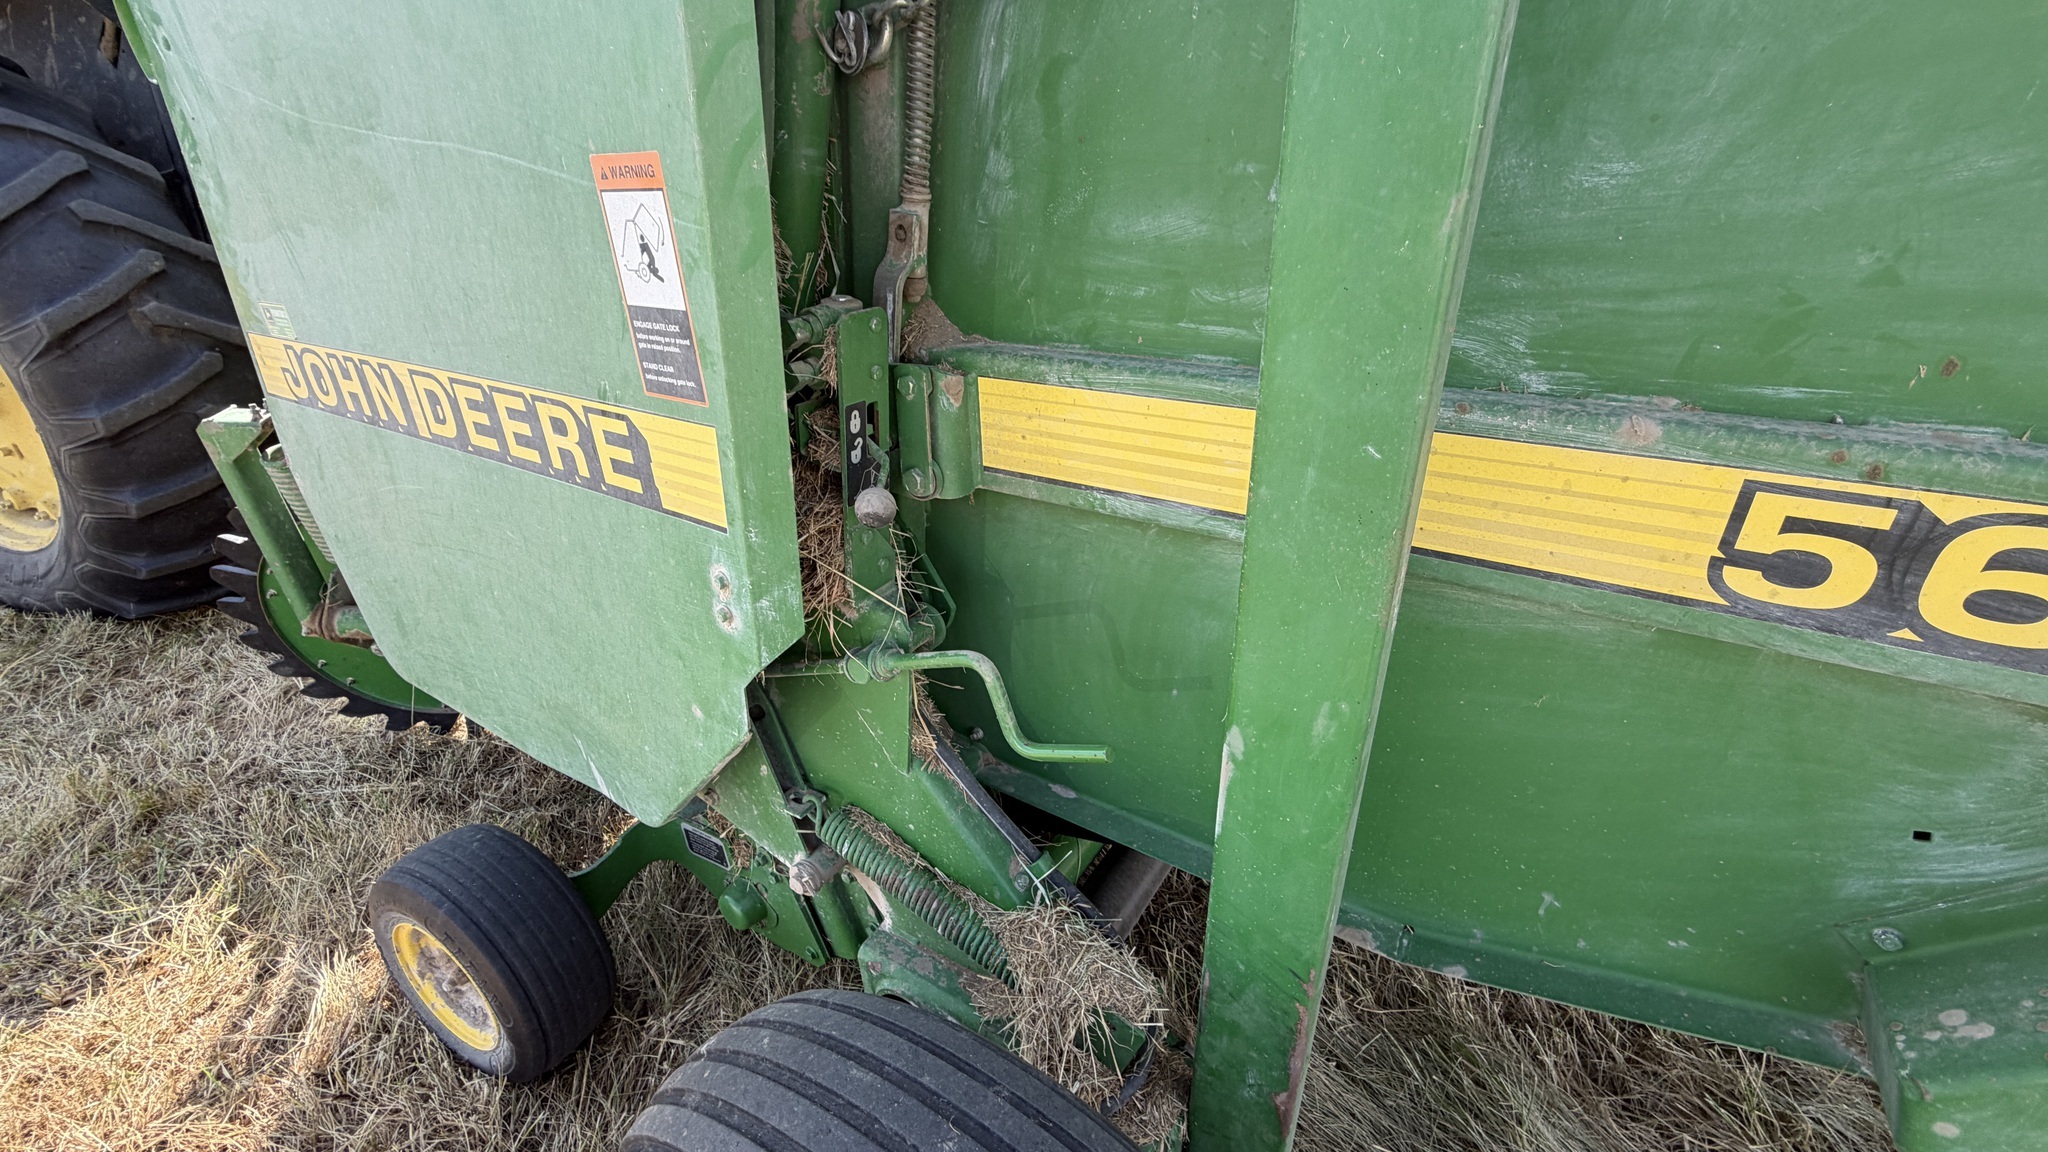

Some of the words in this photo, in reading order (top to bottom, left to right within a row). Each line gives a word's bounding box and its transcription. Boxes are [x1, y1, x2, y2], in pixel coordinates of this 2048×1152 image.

[608, 163, 656, 180] WARNING
[633, 320, 653, 329] ENGAGE
[653, 322, 666, 331] GATE
[666, 324, 680, 332] LOCK
[643, 361, 658, 371] STAND
[659, 364, 674, 373] CLEAR
[282, 343, 408, 428] JOHN
[416, 374, 643, 495] DEERE
